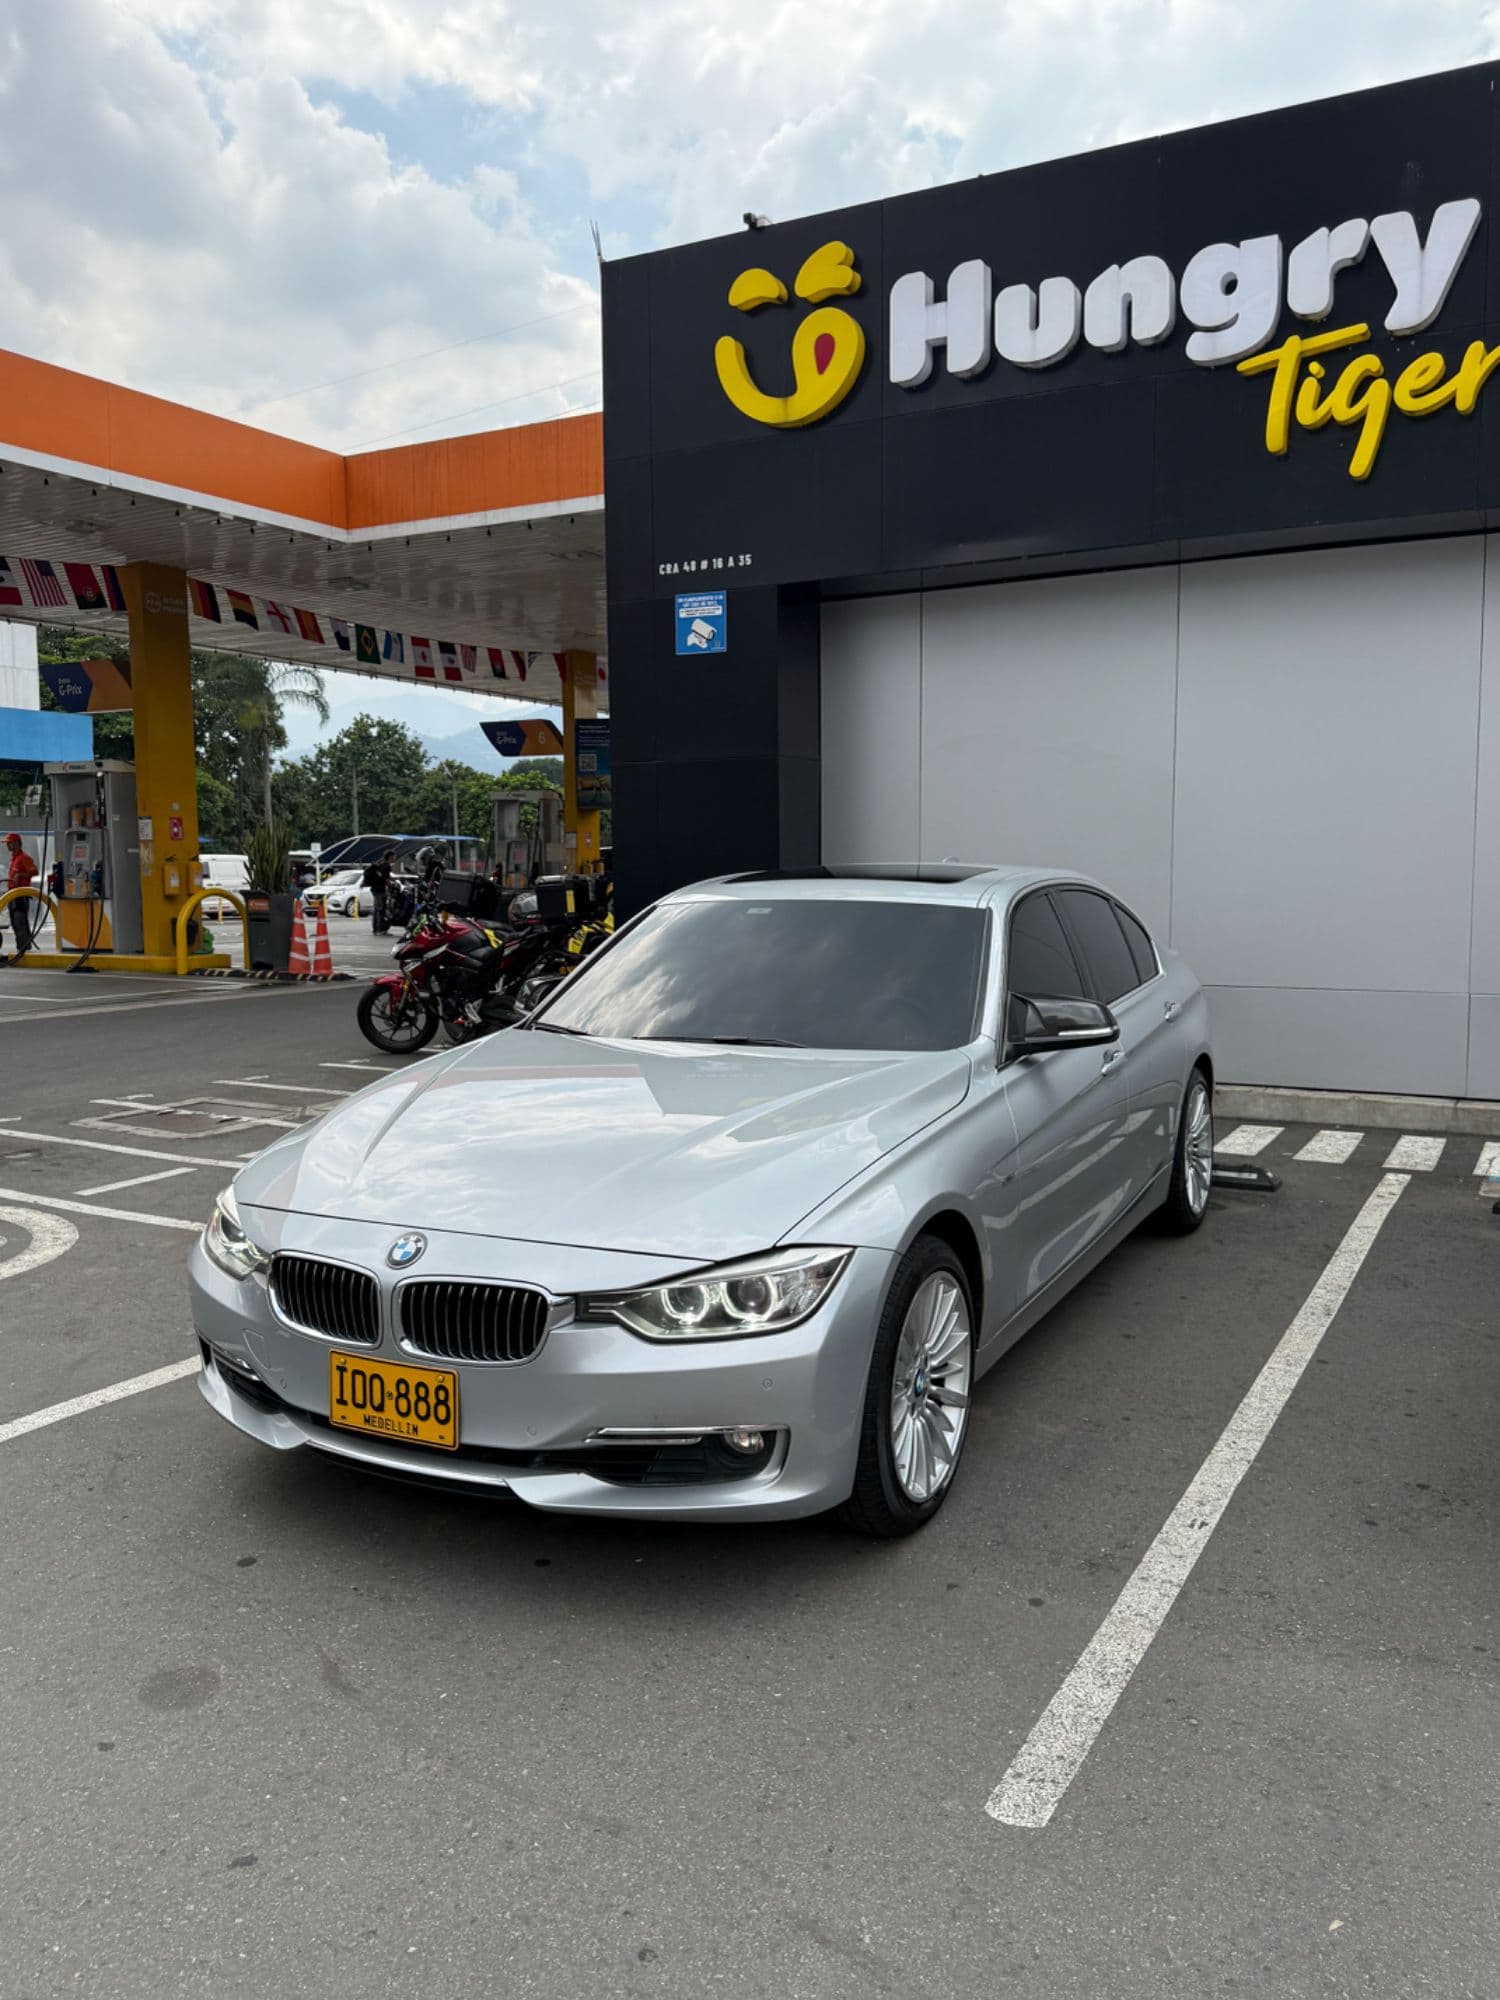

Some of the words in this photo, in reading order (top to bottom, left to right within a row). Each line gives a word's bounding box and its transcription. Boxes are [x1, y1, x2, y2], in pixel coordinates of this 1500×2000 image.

[890, 199, 1482, 389] Hungry
[1236, 323, 1500, 480] Tiger
[727, 555, 735, 568] A
[738, 553, 752, 567] 35
[363, 1413, 418, 1436] MEDELLIN
[395, 1378, 451, 1426] 888
